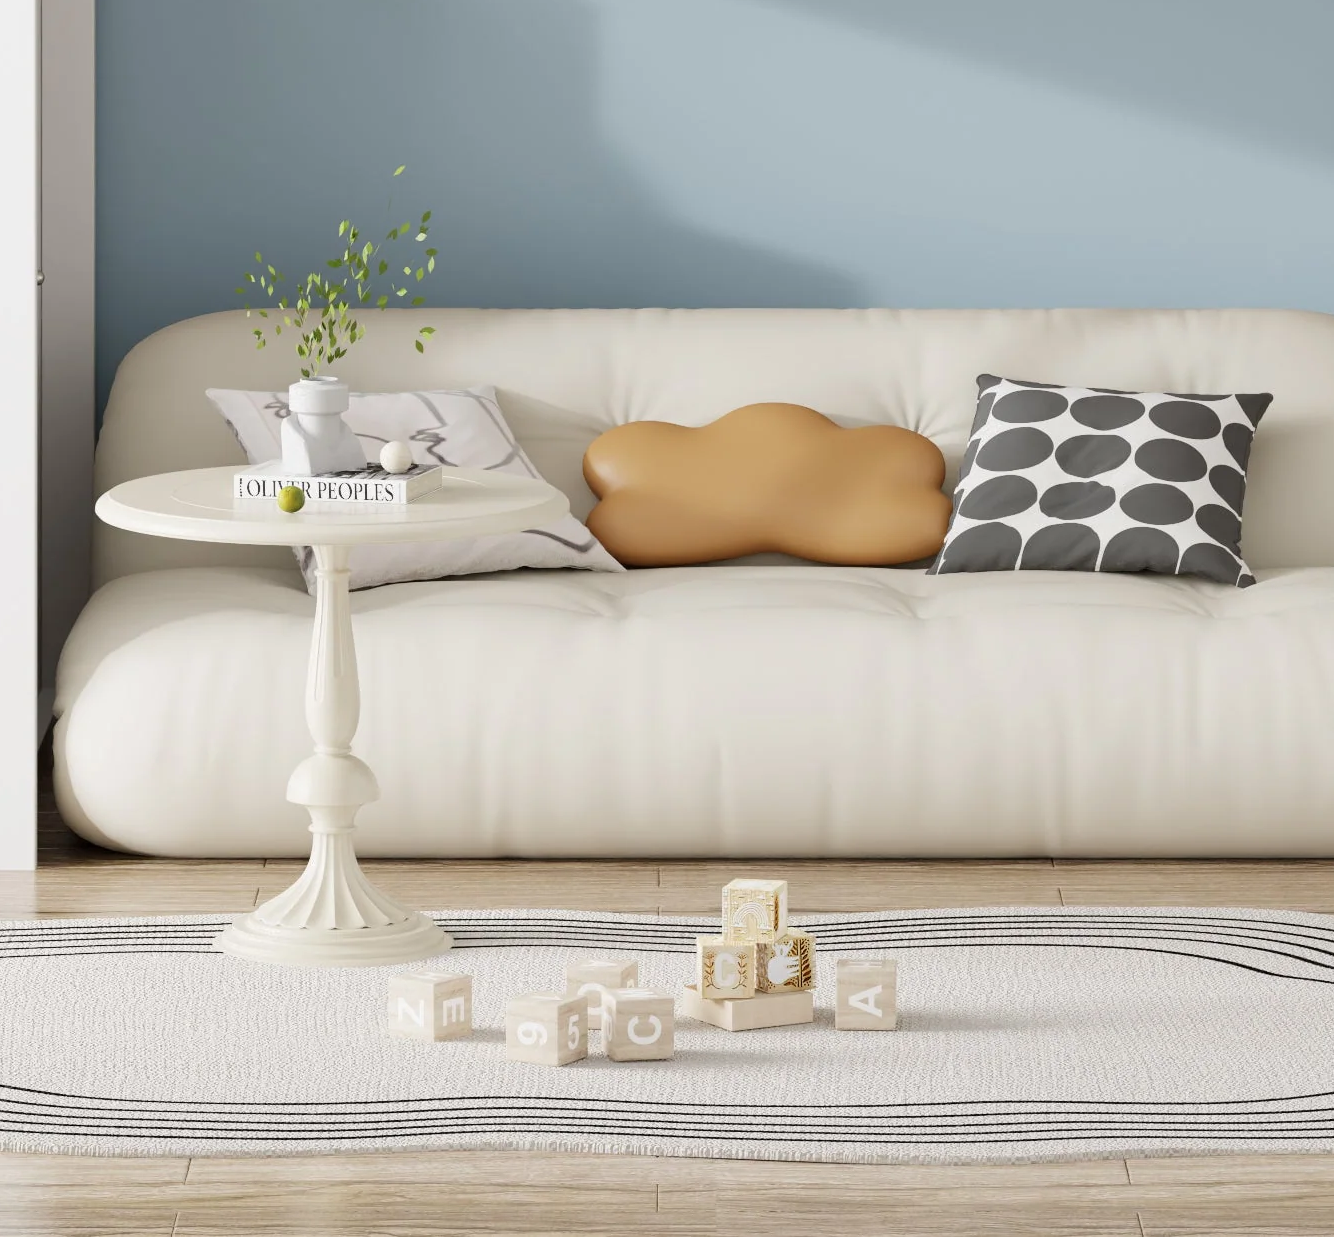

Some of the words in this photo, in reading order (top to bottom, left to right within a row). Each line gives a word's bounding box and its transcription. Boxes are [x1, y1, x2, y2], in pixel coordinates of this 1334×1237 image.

[318, 481, 395, 502] PEOPLES
[713, 951, 737, 989] C
[847, 984, 884, 1019] A
[567, 1013, 580, 1051] 5
[627, 1014, 662, 1045] C
